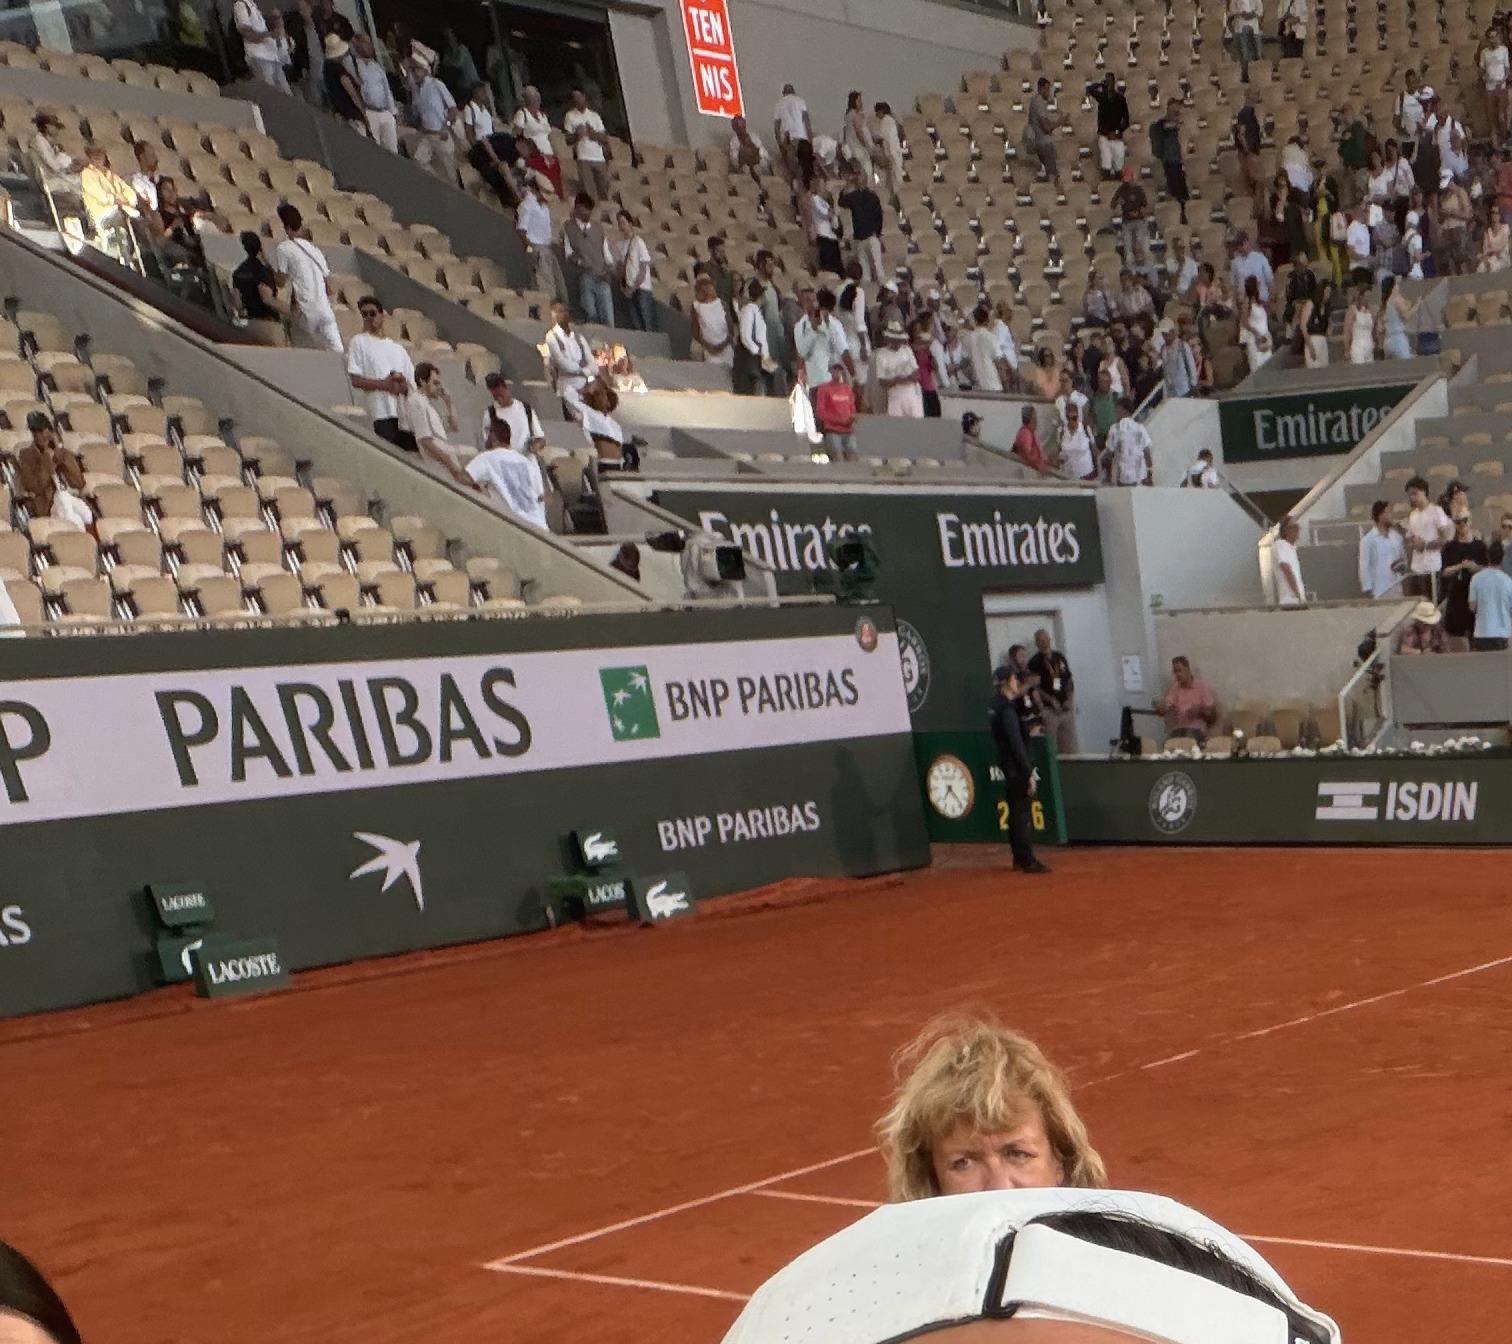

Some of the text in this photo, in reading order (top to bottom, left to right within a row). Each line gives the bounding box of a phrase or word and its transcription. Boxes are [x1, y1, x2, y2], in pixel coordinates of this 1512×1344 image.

[688, 6, 725, 46] TEN
[700, 63, 733, 102] NIS
[936, 510, 1080, 567] Emirates
[666, 668, 859, 721] BNP PARIBAS
[154, 666, 532, 787] PARIBAS
[1385, 781, 1479, 821] ISDIN
[657, 800, 820, 851] BNP PARIBAS
[0, 905, 31, 947] S
[208, 952, 282, 984] LACOSTE
